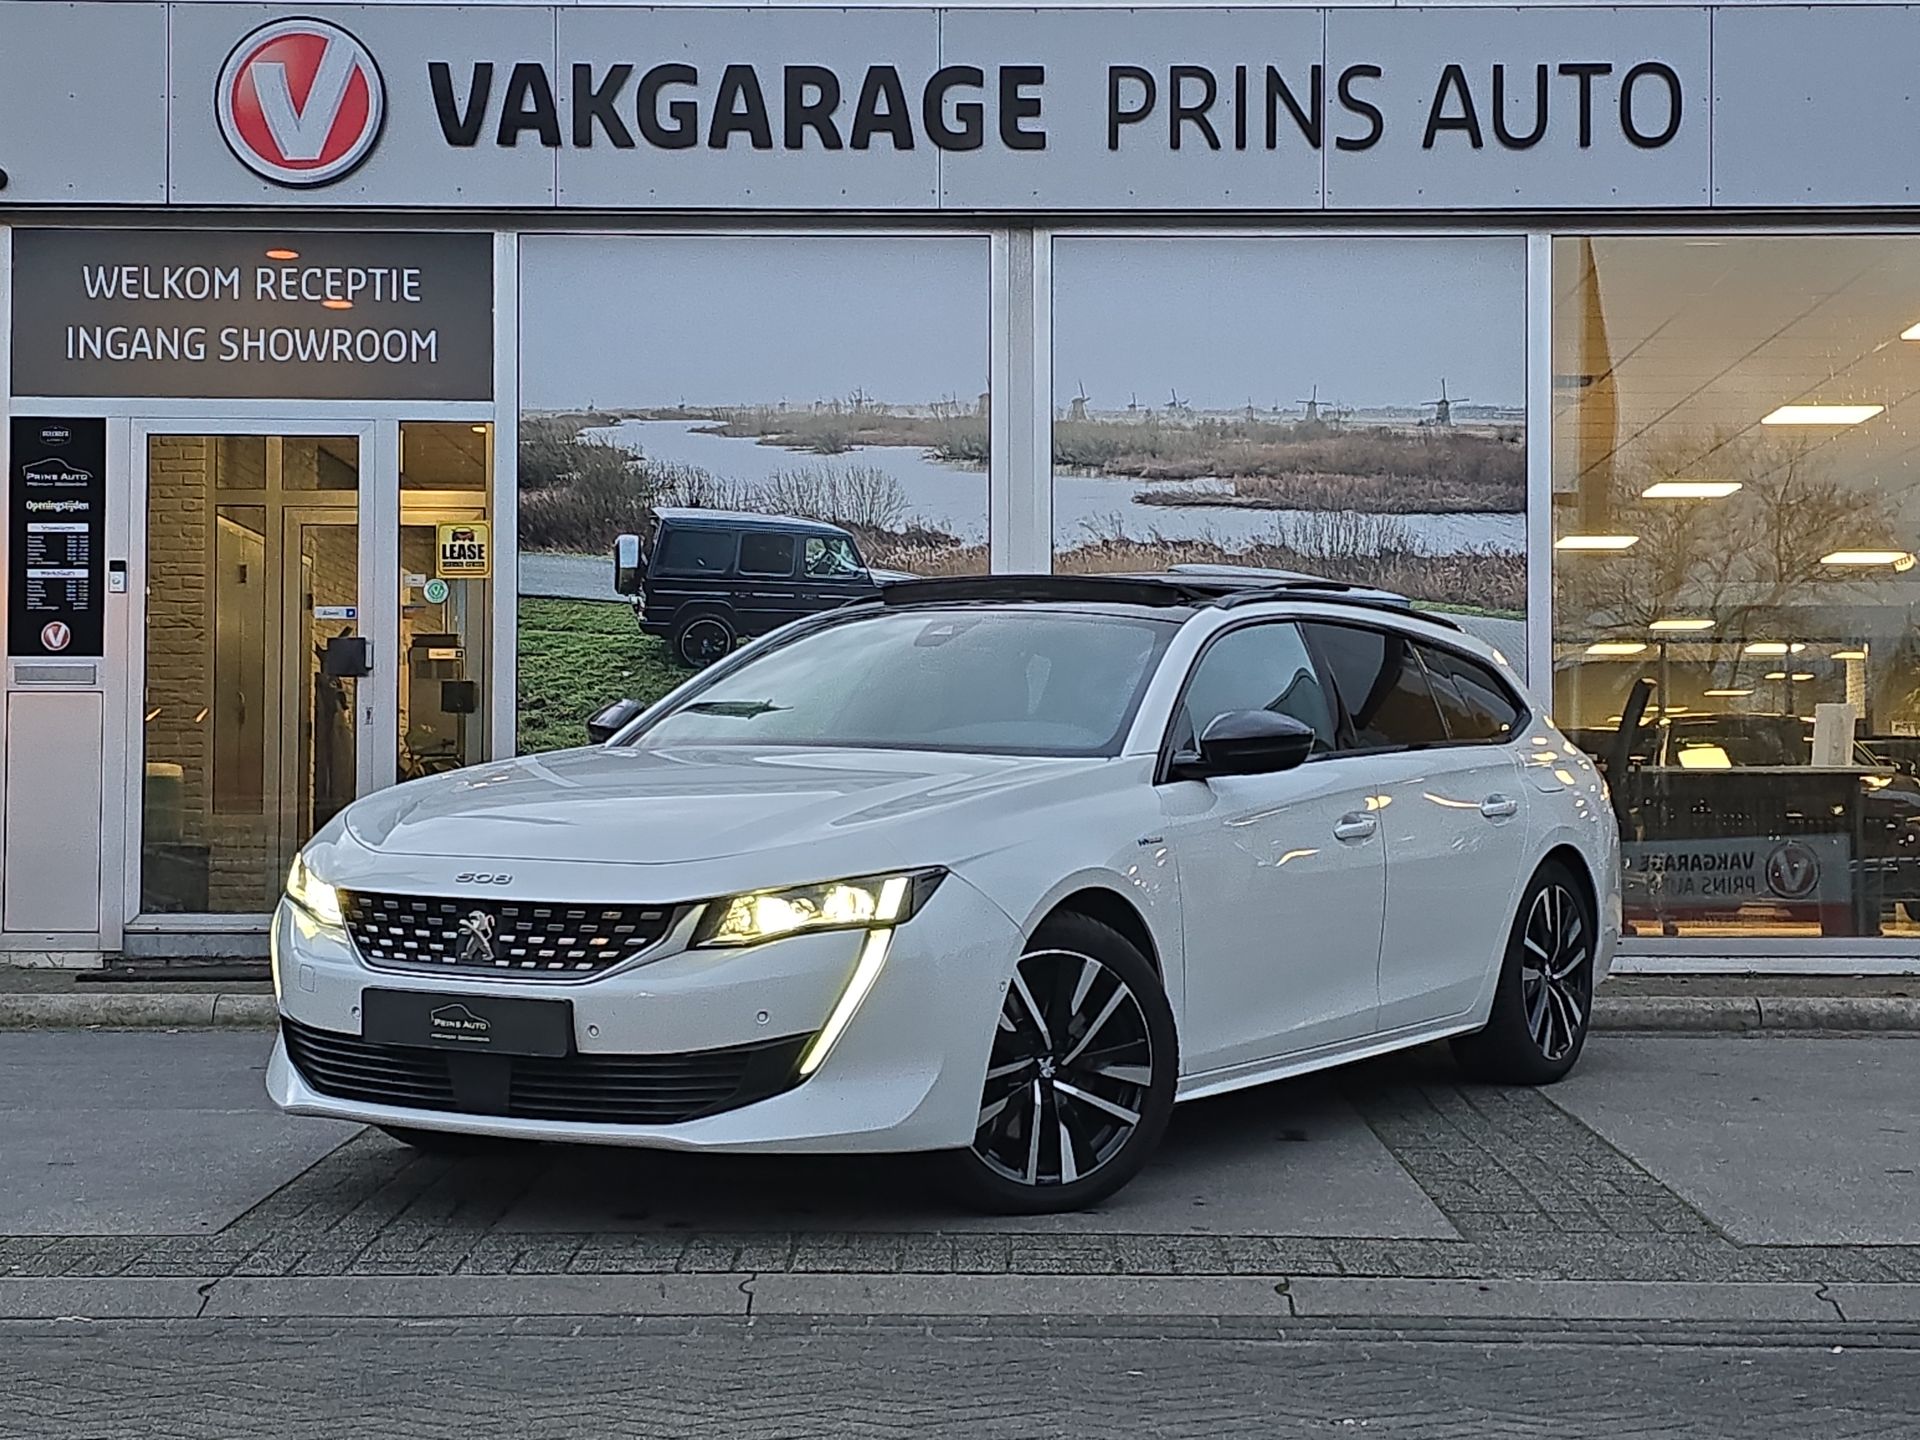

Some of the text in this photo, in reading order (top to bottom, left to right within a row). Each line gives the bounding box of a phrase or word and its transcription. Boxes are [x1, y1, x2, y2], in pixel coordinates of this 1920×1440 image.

[428, 62, 1683, 150] VAKGARAGE PRINS AUTO
[83, 266, 421, 302] WELKOM RECEPTIE
[66, 326, 437, 363] INGANG SHOWROOM
[442, 544, 485, 560] LEASE
[455, 872, 514, 887] 508
